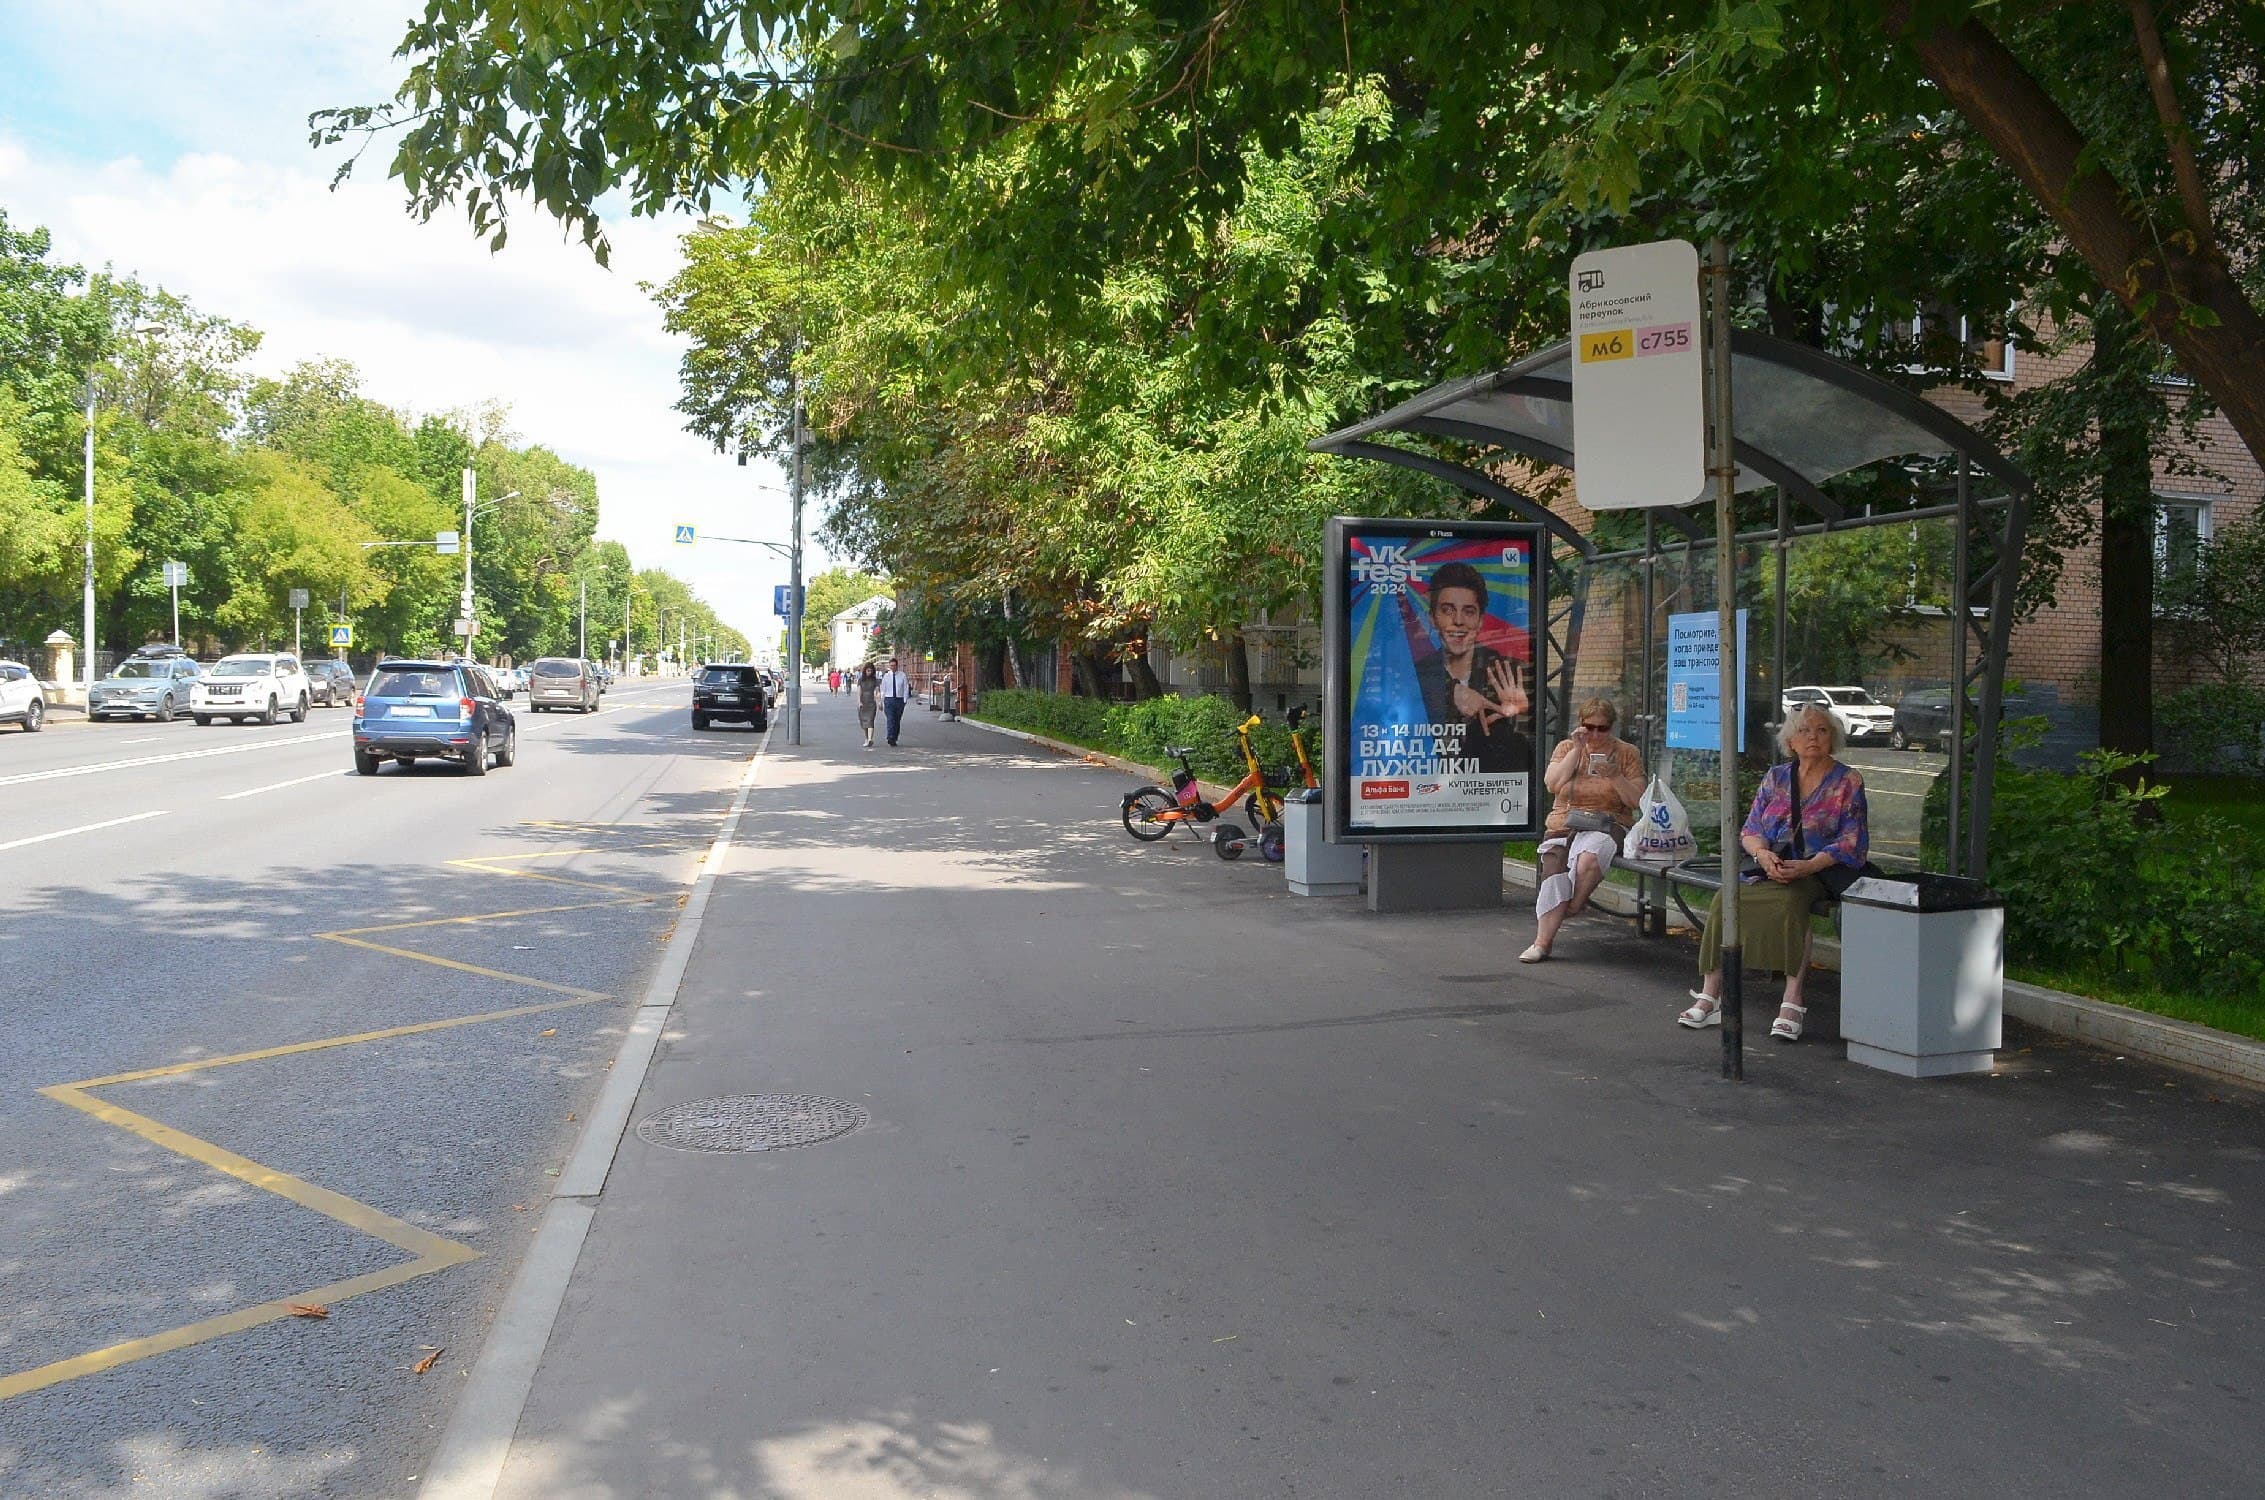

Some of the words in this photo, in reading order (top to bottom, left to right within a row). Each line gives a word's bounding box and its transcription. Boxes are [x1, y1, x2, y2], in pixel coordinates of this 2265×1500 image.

[1579, 292, 1652, 310] Абрикосовский
[1579, 307, 1624, 320] переулок
[1368, 546, 1408, 564] VK
[1505, 554, 1518, 562] VK
[1351, 557, 1428, 582] fest
[1370, 583, 1407, 595] 2024
[1674, 629, 1717, 641] Посмотрите,
[1674, 645, 1692, 653] когда
[1693, 643, 1720, 655] приеде
[1673, 659, 1687, 667] ваш
[1688, 658, 1720, 669] транспор
[1360, 724, 1379, 738] 13
[1391, 723, 1410, 737] 14
[1414, 723, 1467, 737] ИЮЛЯ
[1359, 739, 1426, 758] ВЛАД
[1360, 757, 1480, 777] ЛУЖНИКИ
[1448, 780, 1485, 789] КУПИТЬ
[1486, 779, 1523, 787] БИЛЕТЫ
[1462, 787, 1510, 795] VKFEST.RU
[1500, 798, 1523, 814] 0+
